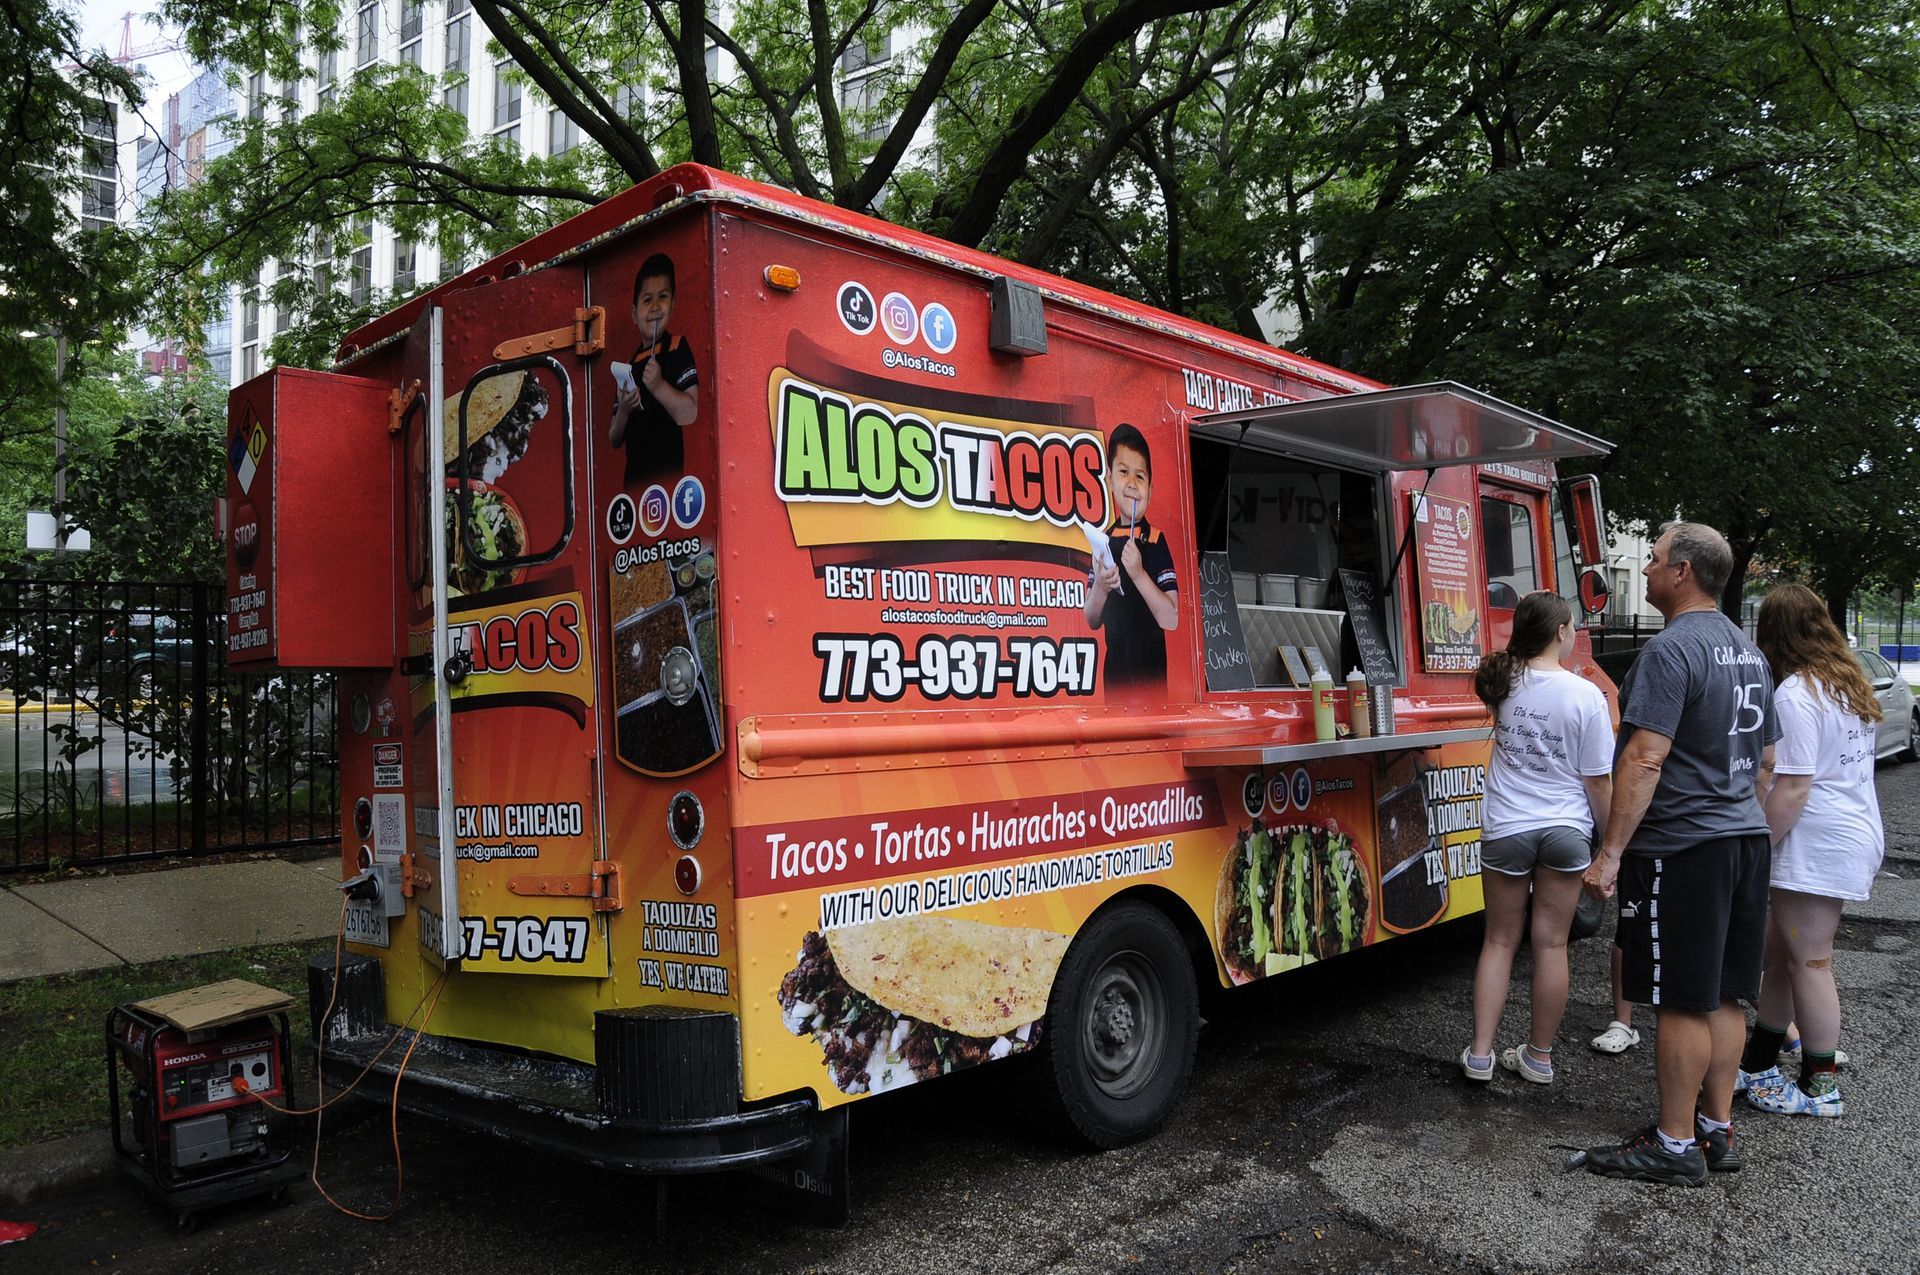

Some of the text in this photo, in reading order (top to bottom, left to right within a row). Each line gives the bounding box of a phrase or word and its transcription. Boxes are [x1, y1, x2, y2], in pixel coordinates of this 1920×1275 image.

[845, 310, 870, 324] Tik Tok
[882, 348, 955, 376] @AlosTacos
[1182, 368, 1215, 411] TACO
[1215, 378, 1253, 413] CARTS
[253, 429, 261, 457] 0
[781, 385, 1106, 526] ALOS TACOS
[1503, 465, 1520, 478] TACO
[1433, 504, 1452, 521] TACOS
[234, 523, 257, 550] STOP
[615, 538, 700, 572] @AlosTacos
[825, 565, 1085, 608] BEST FOOD TRUCK IN CHICAGO
[230, 591, 266, 614] 773-937-7647
[881, 608, 1047, 629] alostacosfoodtruck@gmail.com
[1203, 620, 1231, 638] Pork
[817, 639, 1096, 697] 773-937-7647
[1427, 655, 1480, 670] 773-937-7647
[1513, 706, 1527, 718] 27th
[1727, 683, 1764, 735] 25
[1540, 729, 1563, 745] Chicago
[378, 750, 398, 761] DANGER
[1315, 778, 1353, 795] @AlosTacos
[1425, 765, 1485, 801] TAQUIZAS
[483, 807, 500, 837] IN
[505, 804, 582, 836] CHICAGO
[1427, 800, 1482, 836] A DOMICILI
[766, 786, 1203, 879] Tacos Tortas Huaraches Quesadillas
[1424, 849, 1448, 887] YES,
[1447, 844, 1464, 879] WE
[822, 841, 1174, 927] WITH OUR DELICIOUS HANDMADE TORTILLAS
[641, 902, 717, 928] TAQUIZAS
[643, 928, 719, 956] A DOMICILIO
[639, 960, 728, 995] YES, WE CATER!
[164, 1053, 207, 1066] HONDA
